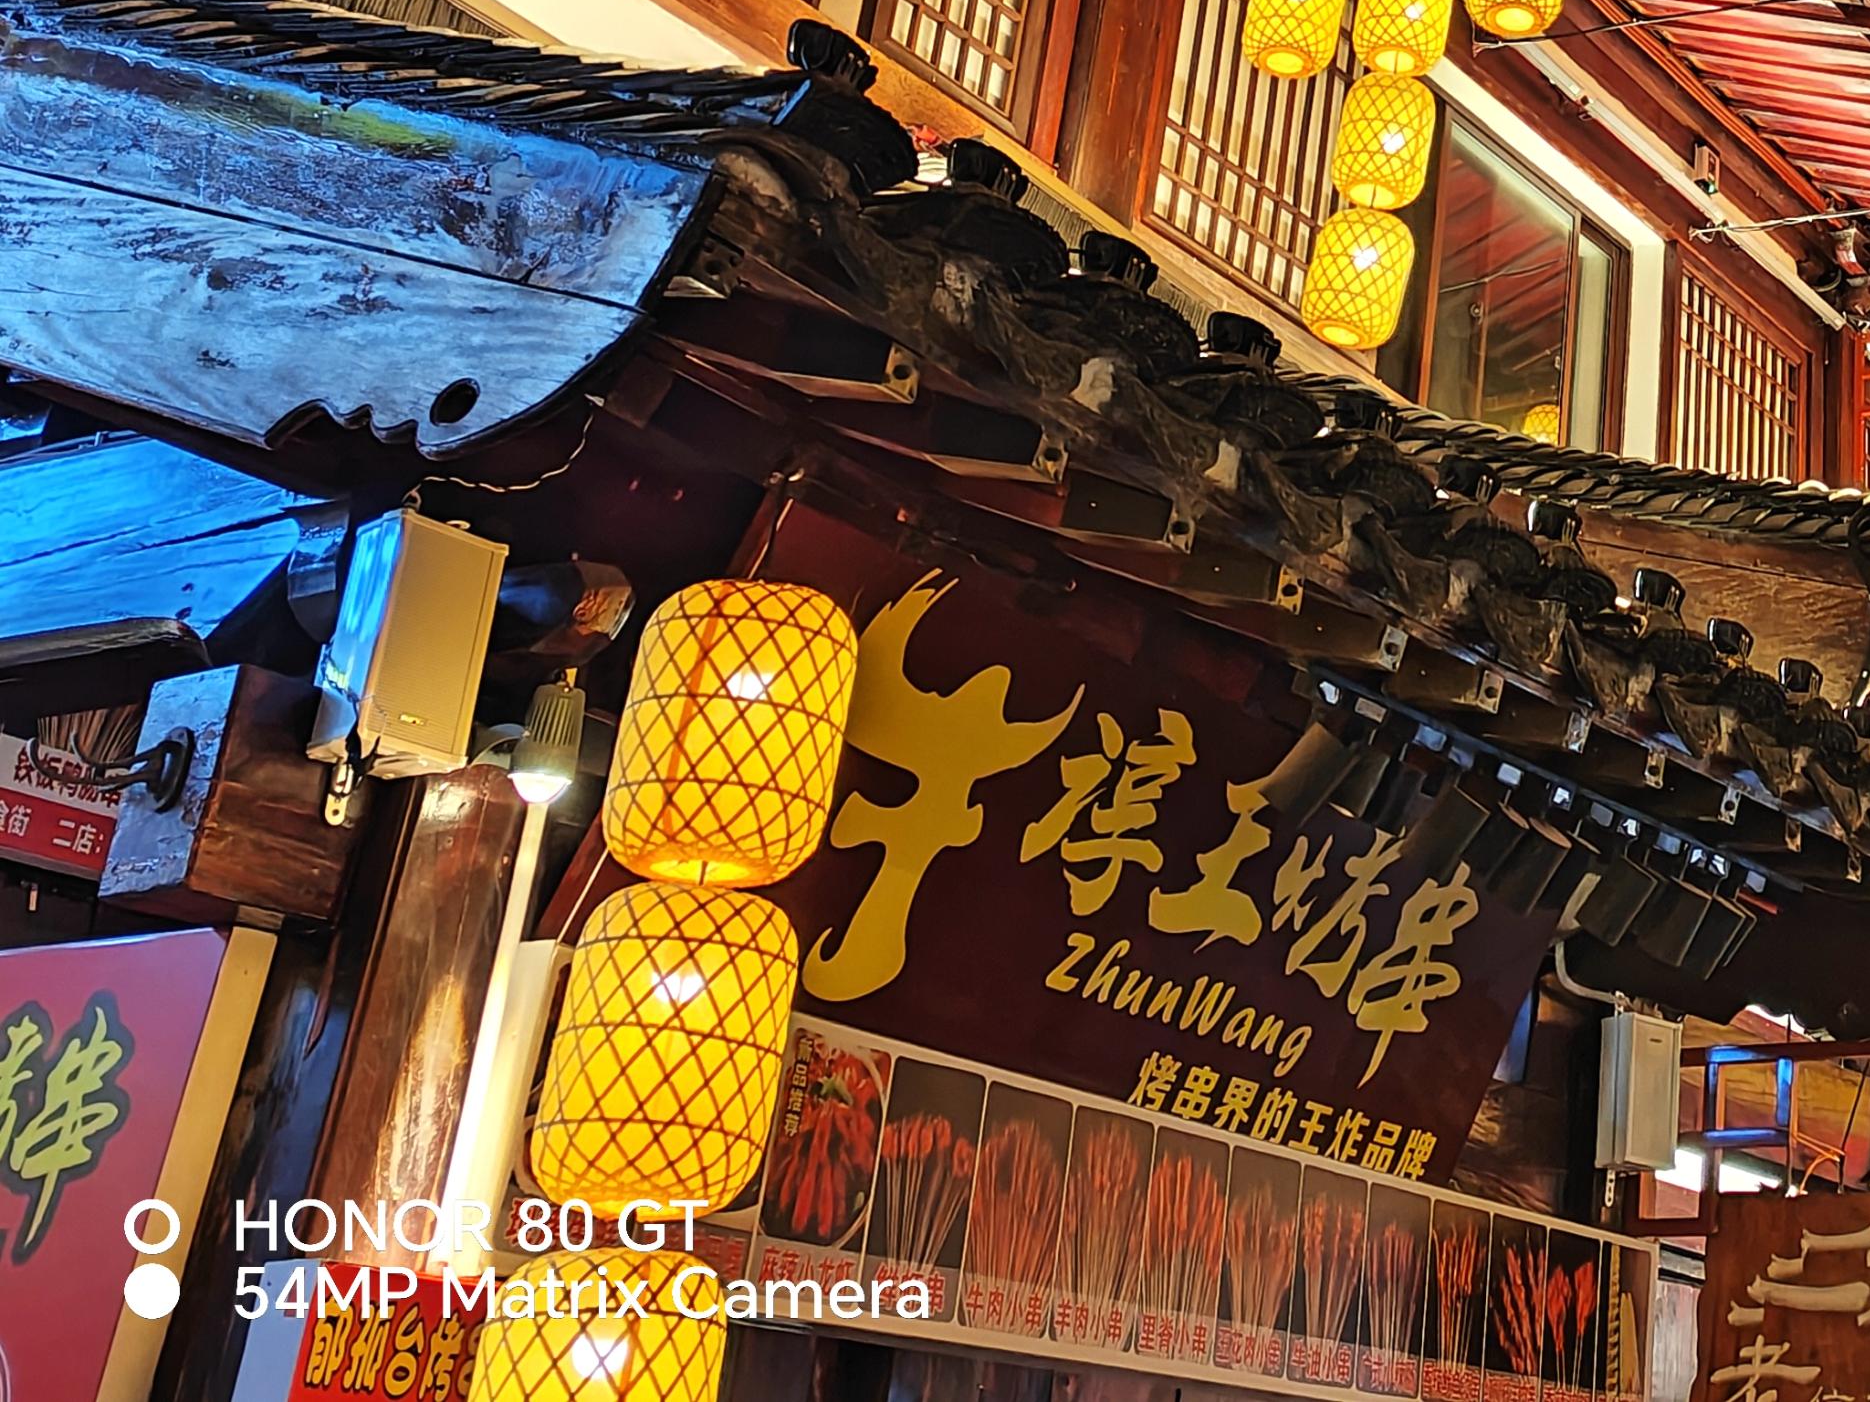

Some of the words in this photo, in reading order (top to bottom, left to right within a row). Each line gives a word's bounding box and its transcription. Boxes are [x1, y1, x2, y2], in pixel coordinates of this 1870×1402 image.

[1046, 932, 1312, 1077] ZhunWang
[1127, 1051, 1438, 1182] 烤串界的王炸品牌
[966, 1285, 1042, 1331] 牛肉小串
[1055, 1299, 1122, 1343] 羊肉小串
[1139, 1315, 1207, 1356] 里脊小串
